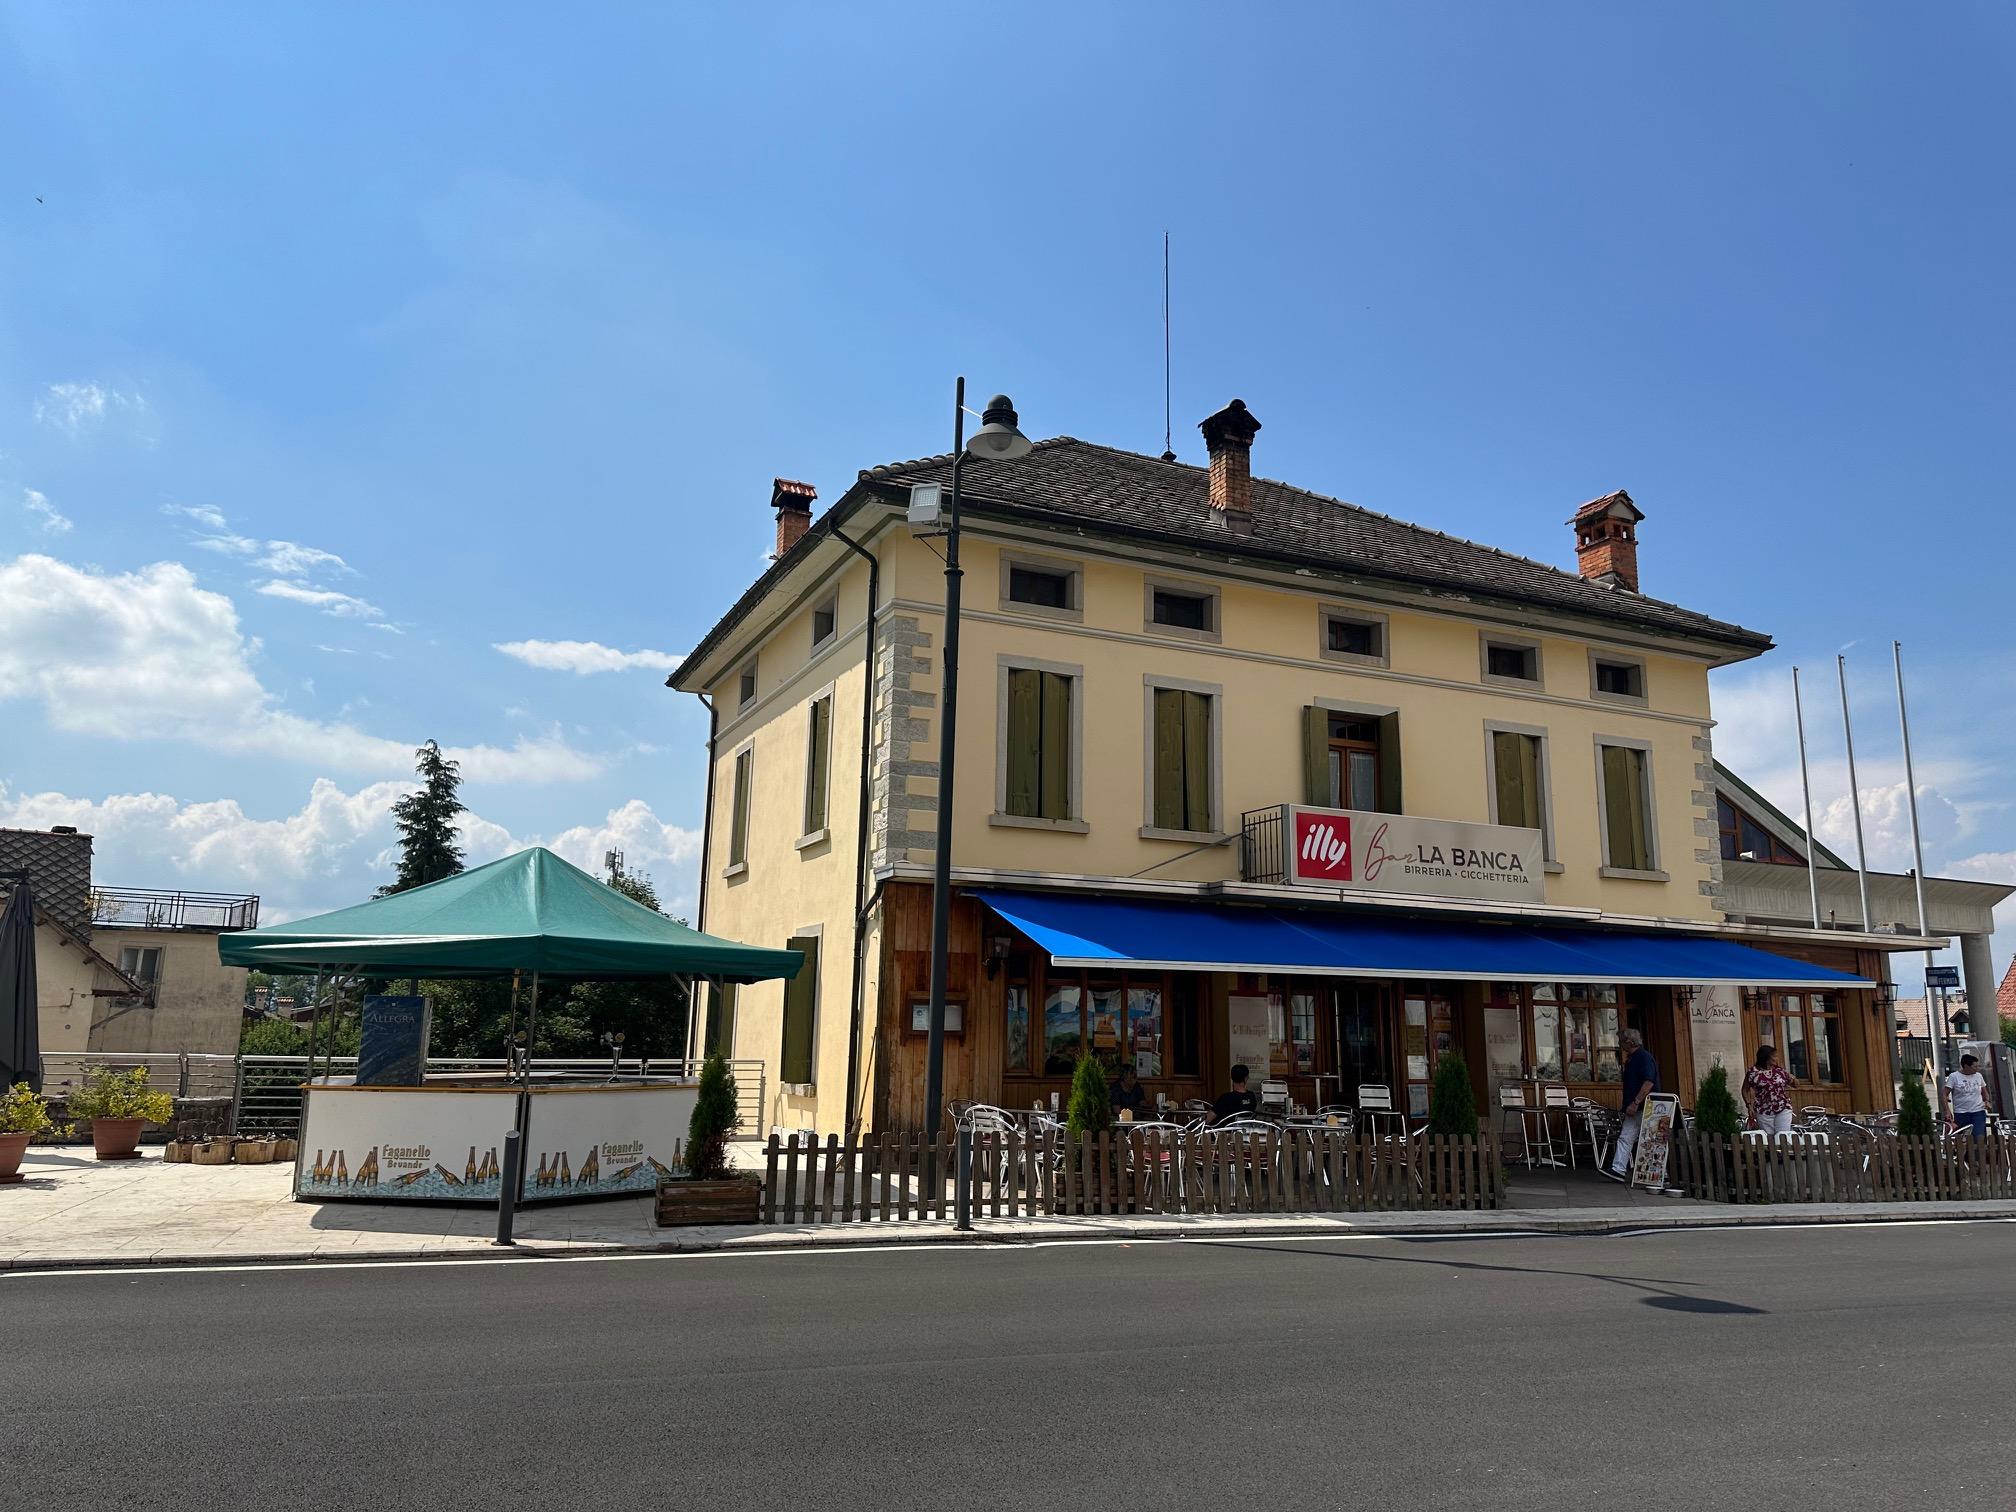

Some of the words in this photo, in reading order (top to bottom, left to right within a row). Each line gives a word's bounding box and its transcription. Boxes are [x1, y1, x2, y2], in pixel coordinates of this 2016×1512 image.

[1302, 823, 1347, 871] illy
[1364, 822, 1417, 881] Bar
[1417, 845, 1445, 865] LA
[1451, 848, 1523, 872] BANCA
[1404, 865, 1452, 878] BIRRERIA
[1460, 870, 1529, 884] CICCHETTERIA
[370, 1013, 416, 1023] ALLEGRA
[382, 1144, 431, 1160] Faganello
[602, 1140, 643, 1157] Faganello
[387, 1159, 423, 1169] Bevande
